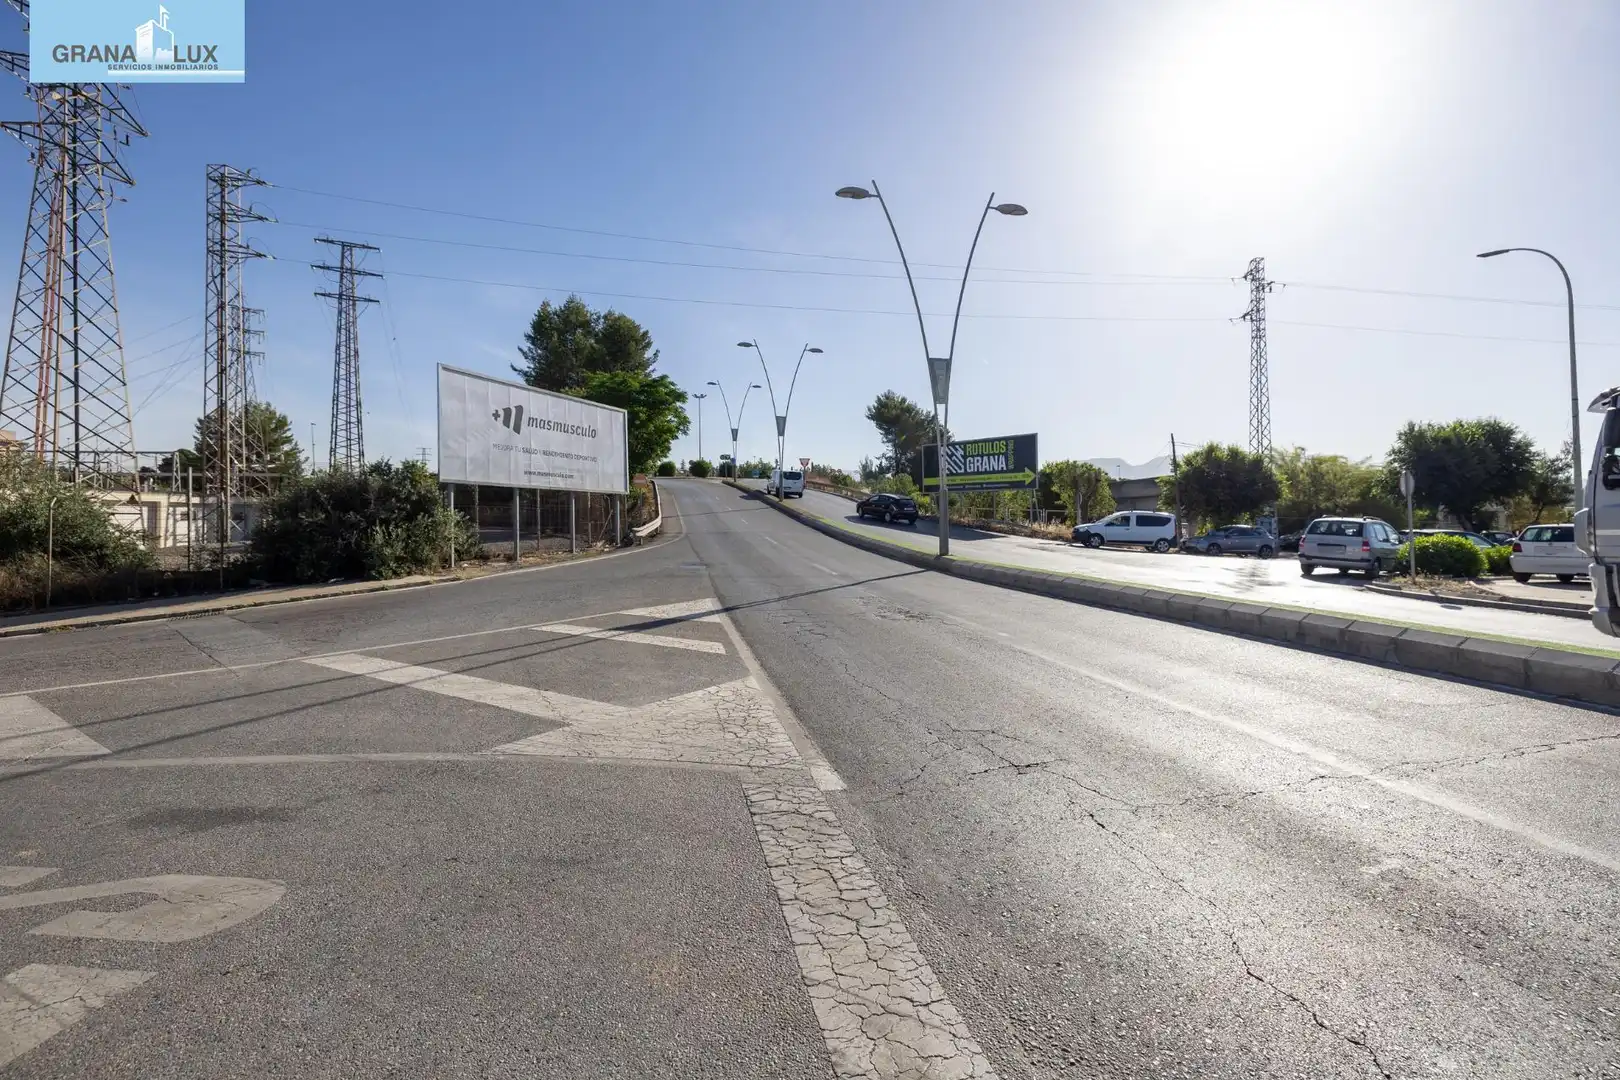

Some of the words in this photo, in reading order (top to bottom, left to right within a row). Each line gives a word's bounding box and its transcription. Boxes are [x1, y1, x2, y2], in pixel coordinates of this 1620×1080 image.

[527, 416, 597, 439] masmusculo
[492, 443, 514, 452] MEJORA
[521, 446, 538, 455] SALUD
[574, 454, 598, 463] DEPORTIVO
[966, 454, 1007, 473] GRANA
